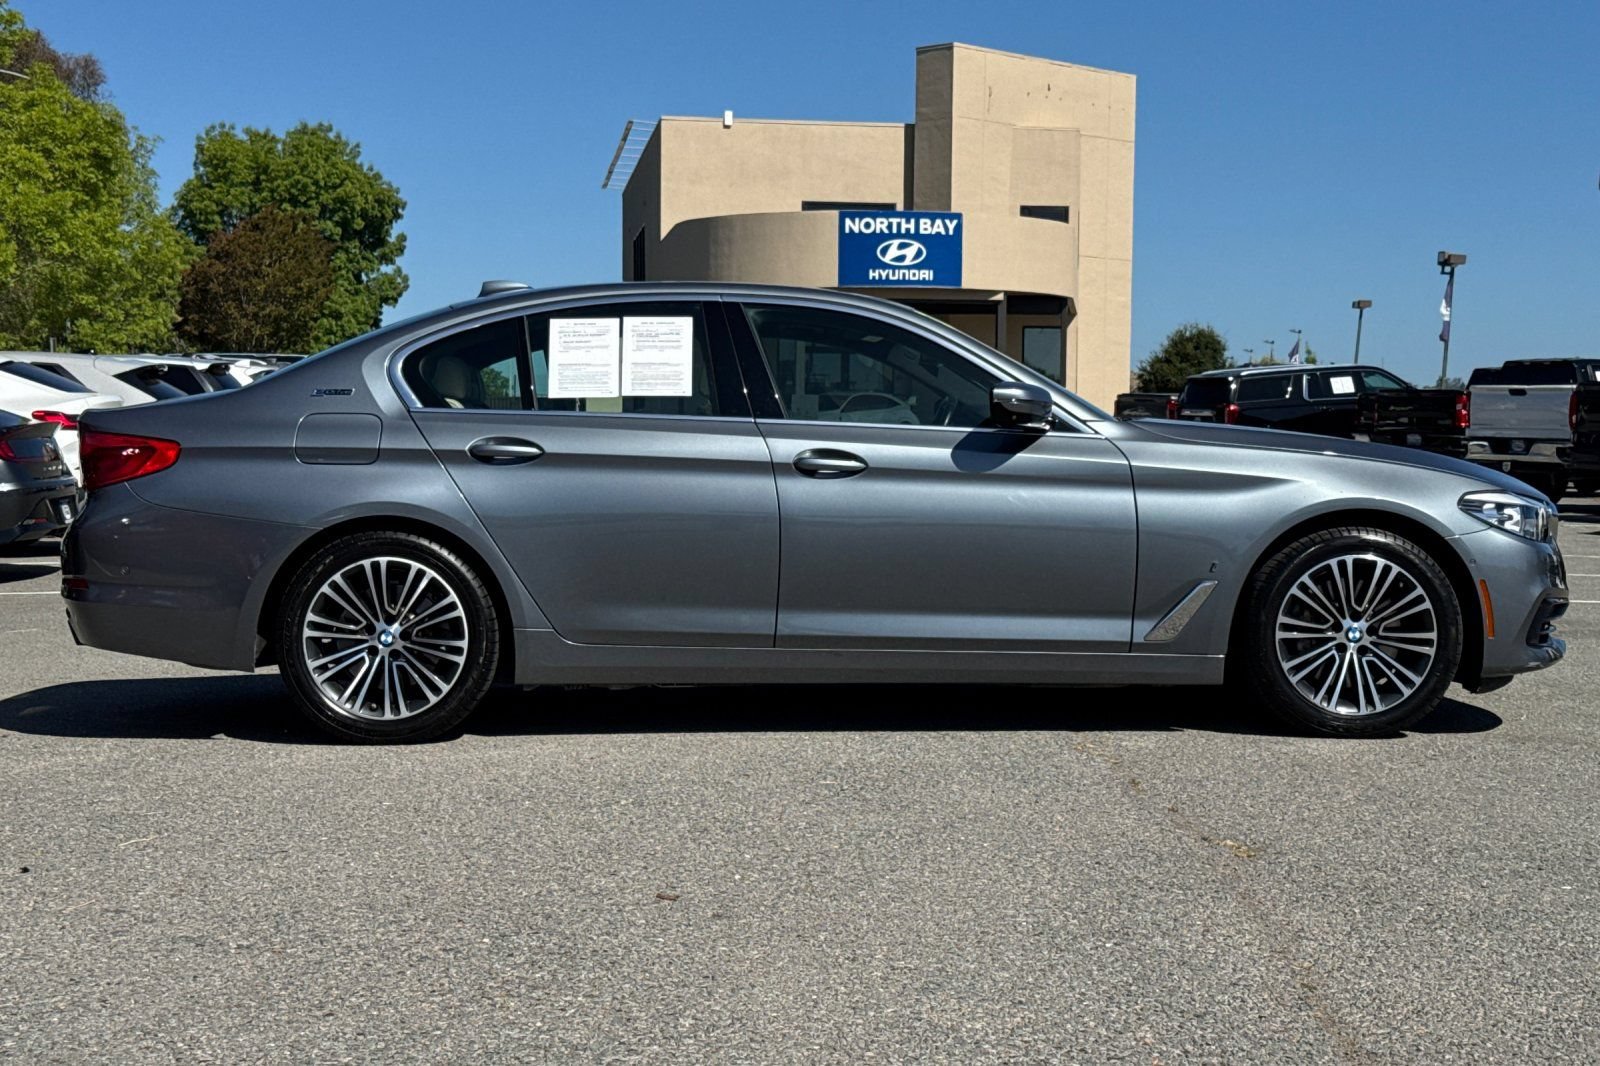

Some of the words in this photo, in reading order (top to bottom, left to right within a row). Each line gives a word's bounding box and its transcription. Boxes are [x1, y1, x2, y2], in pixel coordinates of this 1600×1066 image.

[845, 218, 915, 234] NORTH
[919, 218, 958, 235] BAY
[869, 269, 933, 281] HYUNDAI
